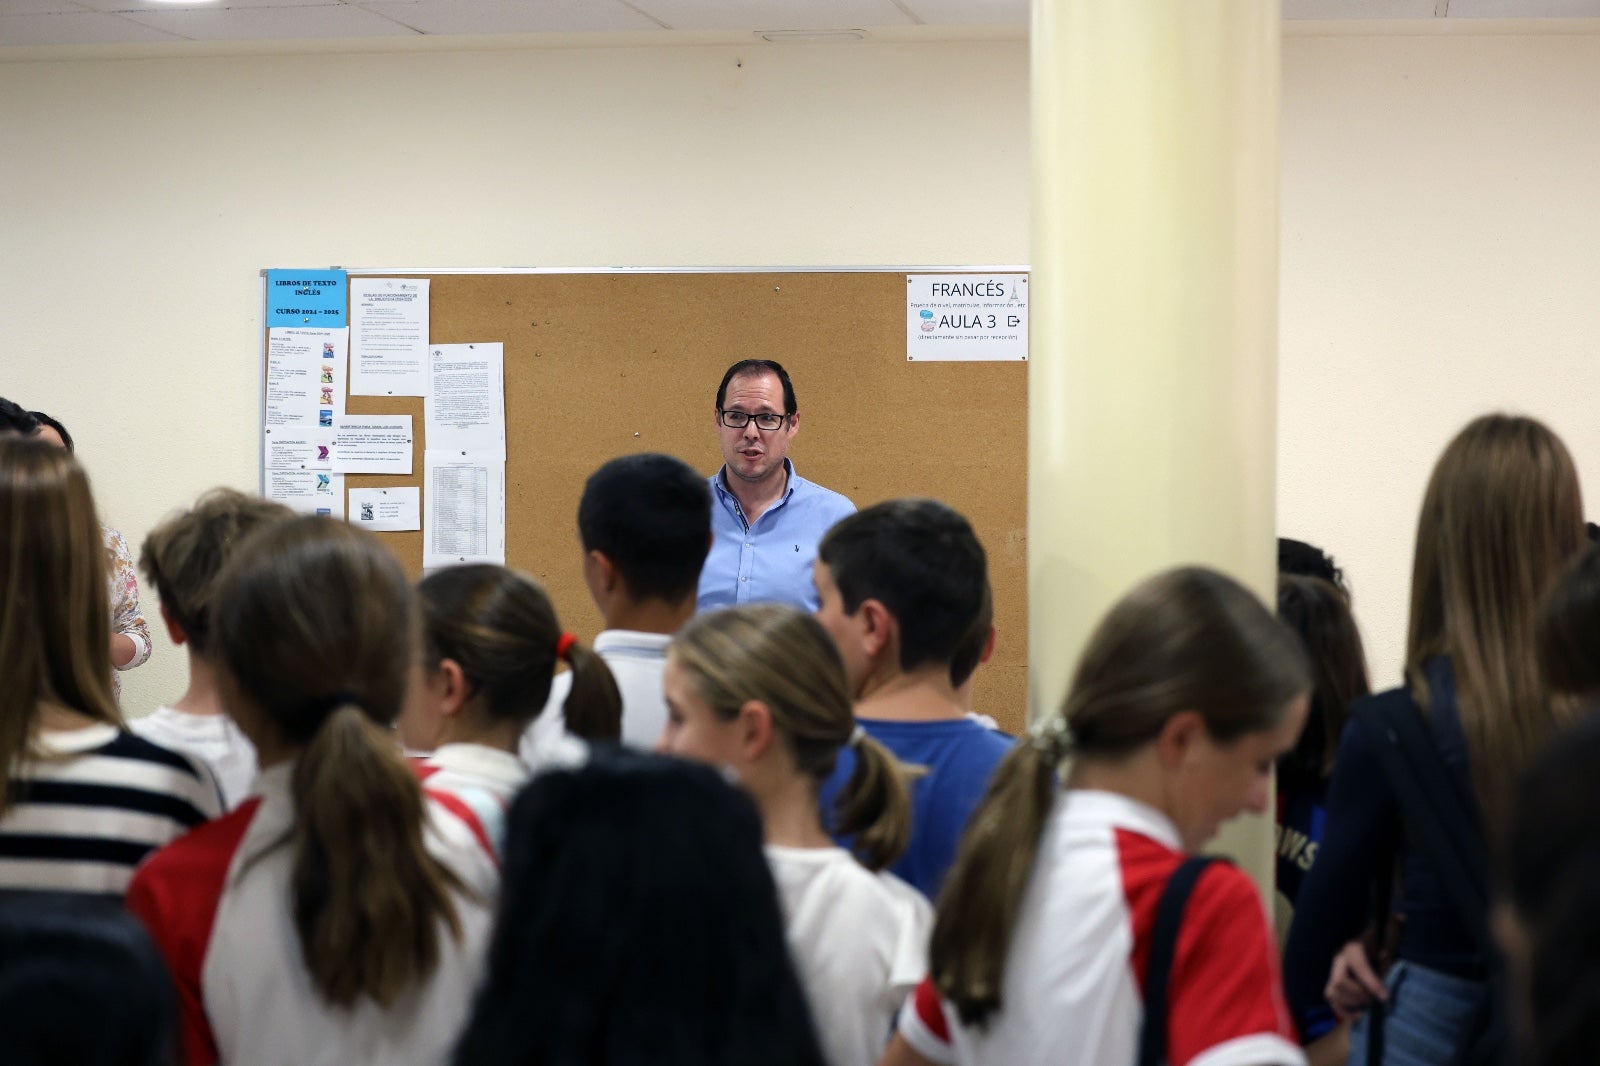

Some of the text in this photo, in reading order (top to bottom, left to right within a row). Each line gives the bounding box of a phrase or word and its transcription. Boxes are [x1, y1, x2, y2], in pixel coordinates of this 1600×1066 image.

[295, 288, 321, 296] INGLÉS
[932, 279, 1005, 297] FRANCÉS
[939, 314, 996, 328] AULA 3
[1275, 823, 1320, 871] WS
